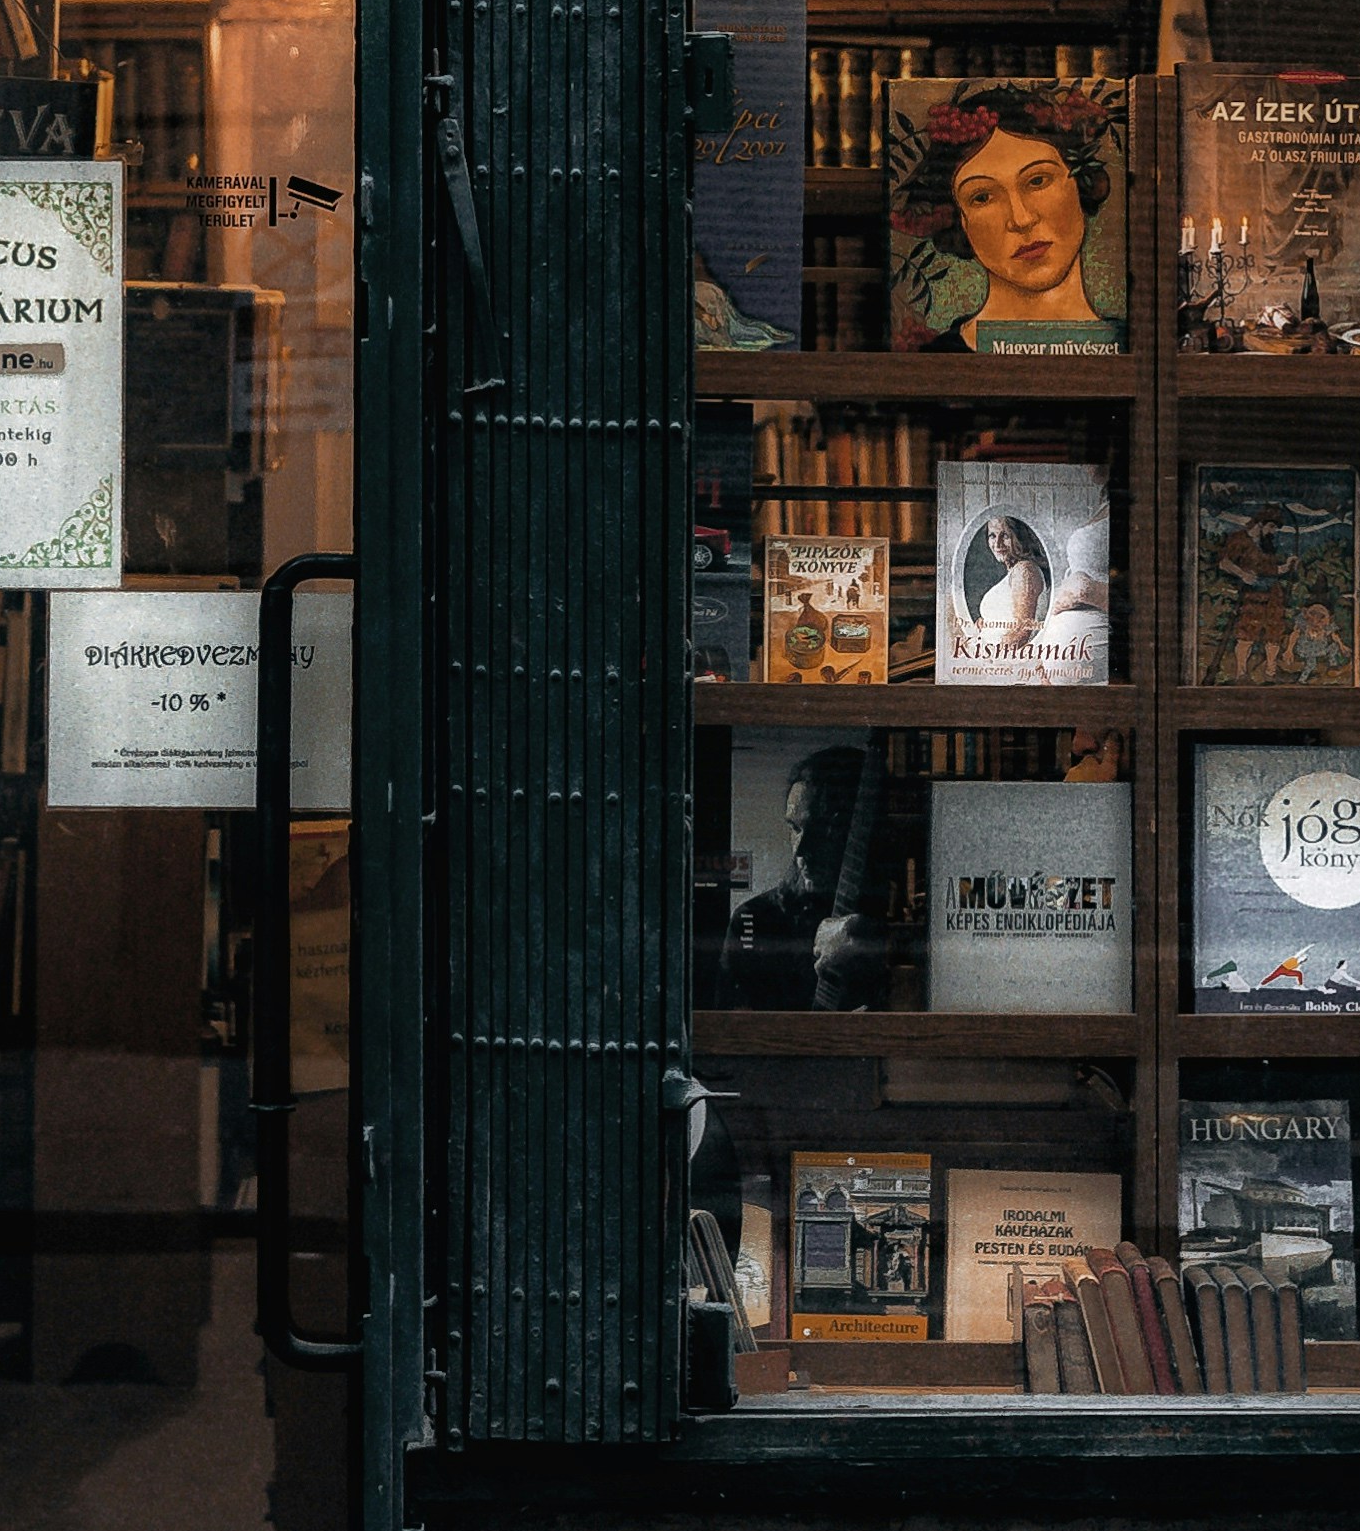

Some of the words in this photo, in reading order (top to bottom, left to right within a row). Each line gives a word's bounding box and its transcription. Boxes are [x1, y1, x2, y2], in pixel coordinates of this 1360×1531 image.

[1211, 101, 1246, 122] AZ
[1255, 96, 1315, 124] ÍZEK
[1238, 129, 1336, 145] GASZTRONÓMIAI
[1251, 150, 1265, 162] AZ
[1269, 149, 1306, 163] OLASZ
[186, 173, 267, 189] KAMERÁVAL
[186, 195, 267, 209] MEGFIGYELT
[198, 212, 256, 227] TERÜLET
[993, 340, 1046, 355] Magyar
[1050, 340, 1120, 355] művészet
[28, 451, 38, 468] h
[791, 544, 864, 560] PIPÁZÓK
[791, 559, 858, 574] KÖNYVE
[952, 634, 1093, 661] Kismamák
[151, 694, 183, 712] -10
[190, 693, 210, 712] %
[1213, 804, 1270, 828] Nők
[946, 909, 990, 931] KÉPES
[996, 909, 1117, 931] ENCIKLOPÉDIÁJA
[1305, 1001, 1342, 1015] Bobby
[1191, 1116, 1341, 1141] HUNGARY
[1003, 1209, 1066, 1223] IRODALMI
[995, 1223, 1074, 1238] KÁVÉHÁZAK
[974, 1242, 1024, 1255] PESTEN
[1028, 1239, 1044, 1256] ÉS
[829, 1319, 919, 1335] Architecture
